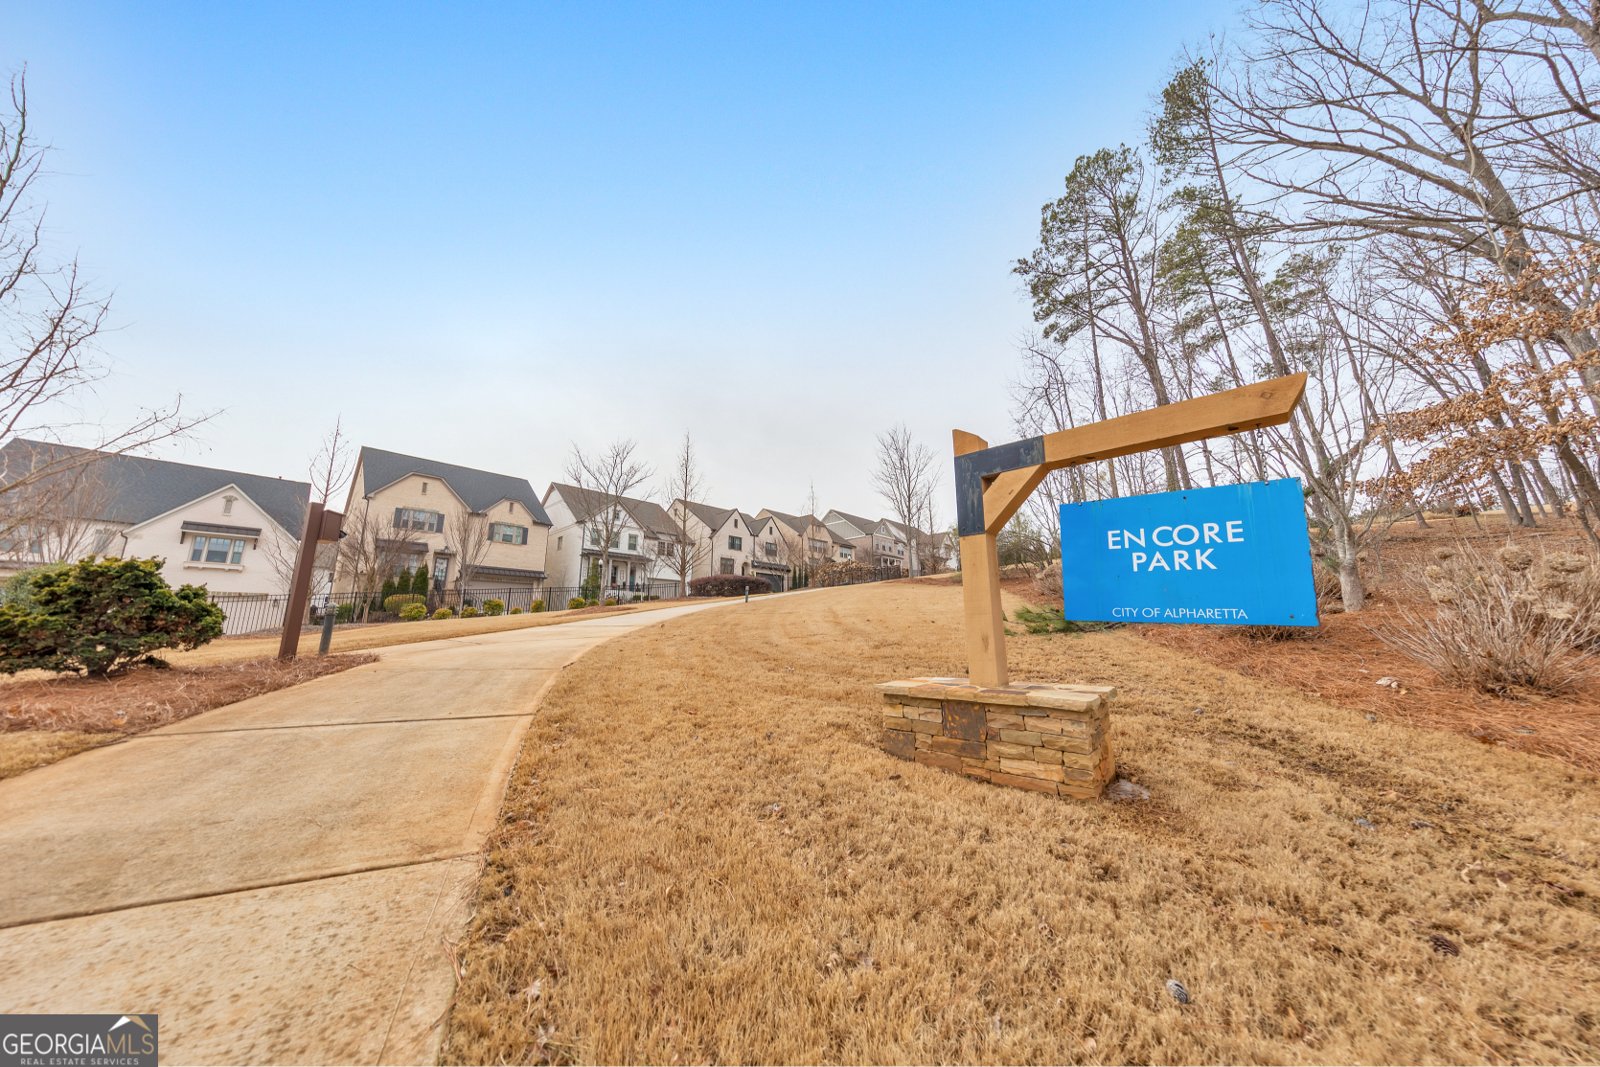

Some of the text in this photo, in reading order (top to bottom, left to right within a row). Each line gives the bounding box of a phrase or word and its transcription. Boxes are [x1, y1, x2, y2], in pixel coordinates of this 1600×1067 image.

[1107, 520, 1245, 550] ENCORE
[1132, 548, 1217, 572] PARK
[1112, 607, 1249, 620] CITY OF ALPHARETTA
